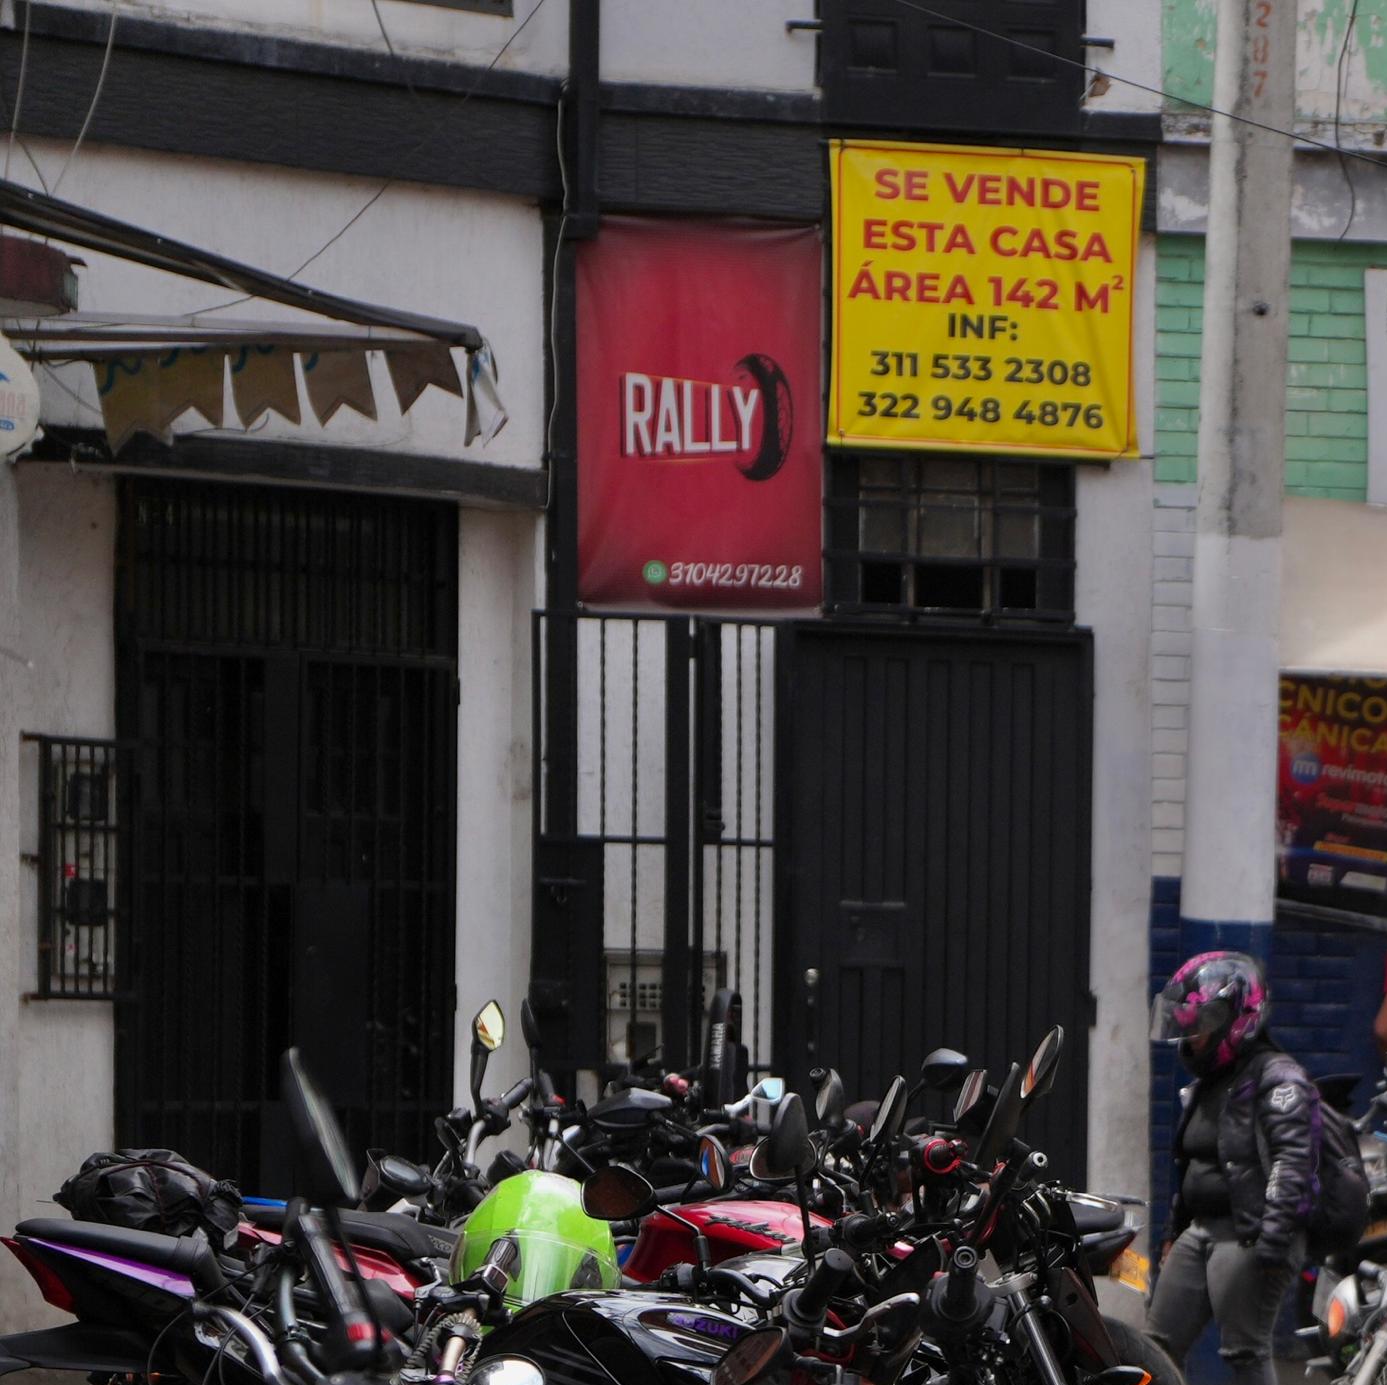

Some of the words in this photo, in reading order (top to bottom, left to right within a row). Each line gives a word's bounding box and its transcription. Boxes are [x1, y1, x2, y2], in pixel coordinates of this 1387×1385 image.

[874, 168, 929, 201] SE
[944, 172, 1101, 212] VENDE
[862, 219, 976, 255] ESTA
[990, 227, 1112, 263] CASA
[847, 261, 974, 305] ÁREA
[987, 276, 1059, 310] 142
[947, 313, 1019, 342] INF:
[870, 351, 919, 377] 311
[930, 354, 993, 381] 533
[1005, 358, 1092, 387] 2308
[622, 371, 760, 458] RALLY
[857, 392, 921, 419] 322
[931, 395, 1001, 423] 948
[1012, 400, 1105, 430] 4876
[668, 560, 803, 588] 3104297228
